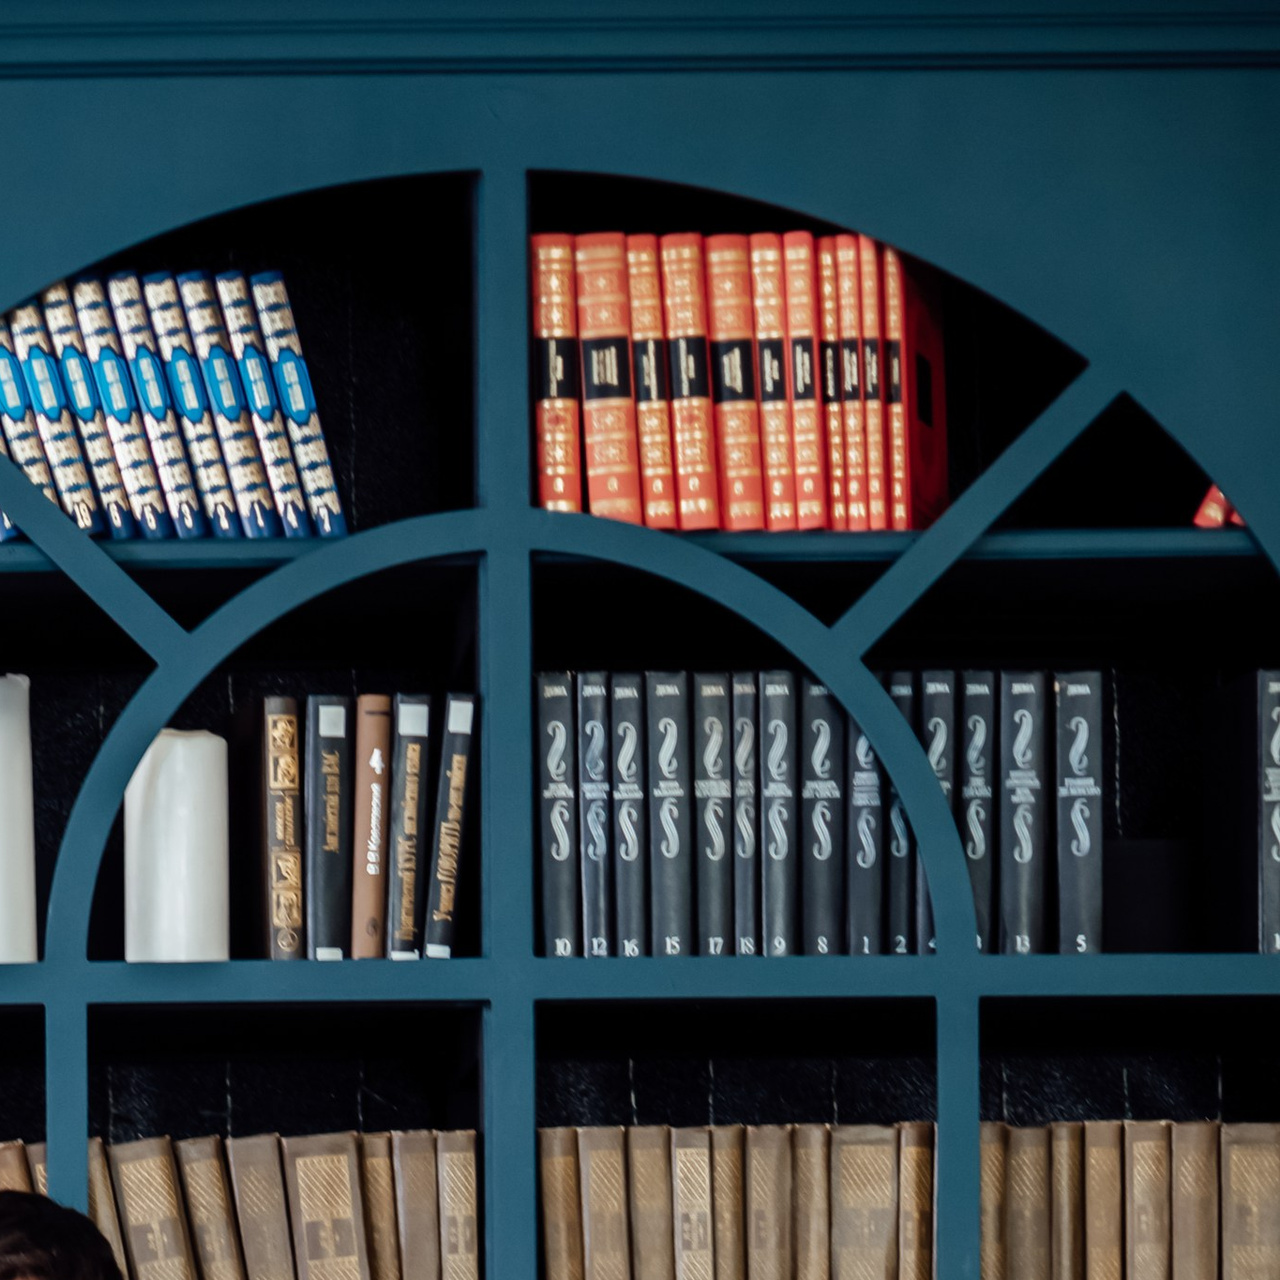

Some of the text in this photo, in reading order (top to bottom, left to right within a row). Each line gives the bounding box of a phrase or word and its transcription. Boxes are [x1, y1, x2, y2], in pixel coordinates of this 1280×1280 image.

[369, 748, 385, 775] 4
[554, 937, 572, 957] 10
[591, 936, 608, 957] 12
[623, 938, 640, 958] 16
[665, 936, 681, 955] 15
[708, 936, 724, 955] 17
[774, 935, 786, 954] 9
[817, 935, 829, 954] 8
[863, 935, 870, 955] 1
[894, 934, 908, 954] 2
[1076, 934, 1087, 953] 5
